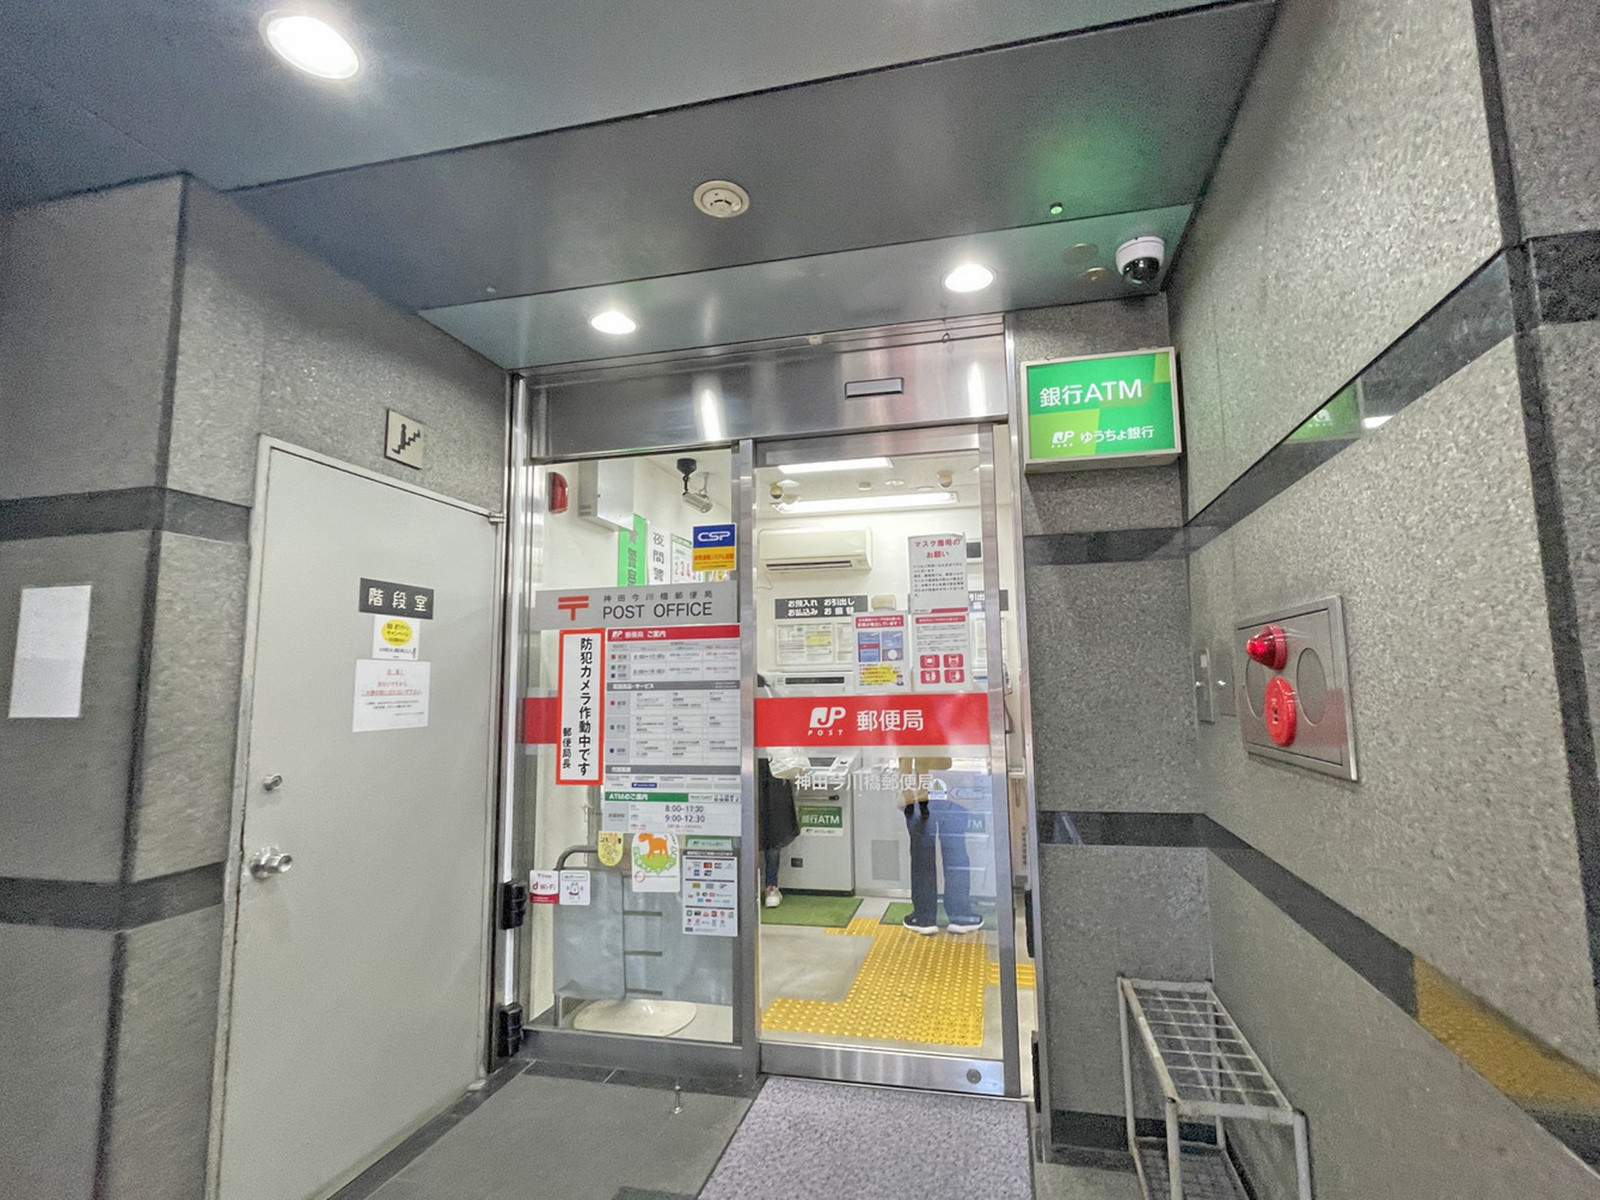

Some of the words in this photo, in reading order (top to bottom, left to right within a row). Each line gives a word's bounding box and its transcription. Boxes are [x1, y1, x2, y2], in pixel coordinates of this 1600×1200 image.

[1040, 378, 1142, 407] 銀行ATM
[1080, 425, 1154, 444] ゆうちょ銀行
[698, 531, 731, 542] CSP
[914, 538, 961, 548] マスク着用の
[926, 550, 949, 559] お願い
[368, 587, 427, 612] 階段室
[603, 590, 713, 602] 神田今川橋郵便局
[788, 599, 818, 607] お預入れ
[824, 598, 855, 606] お引出し
[603, 604, 645, 620] POST
[653, 601, 713, 618] OFFICE
[788, 608, 818, 617] お払込み
[647, 630, 666, 638] ご案内
[578, 637, 593, 776] 防犯カメラ作動中です
[809, 706, 846, 728] JP
[856, 709, 924, 732] 郵便局
[562, 727, 572, 769] 郵便局長
[795, 773, 934, 792] 神田今川橋郵便局
[801, 814, 840, 824] 銀行ATM
